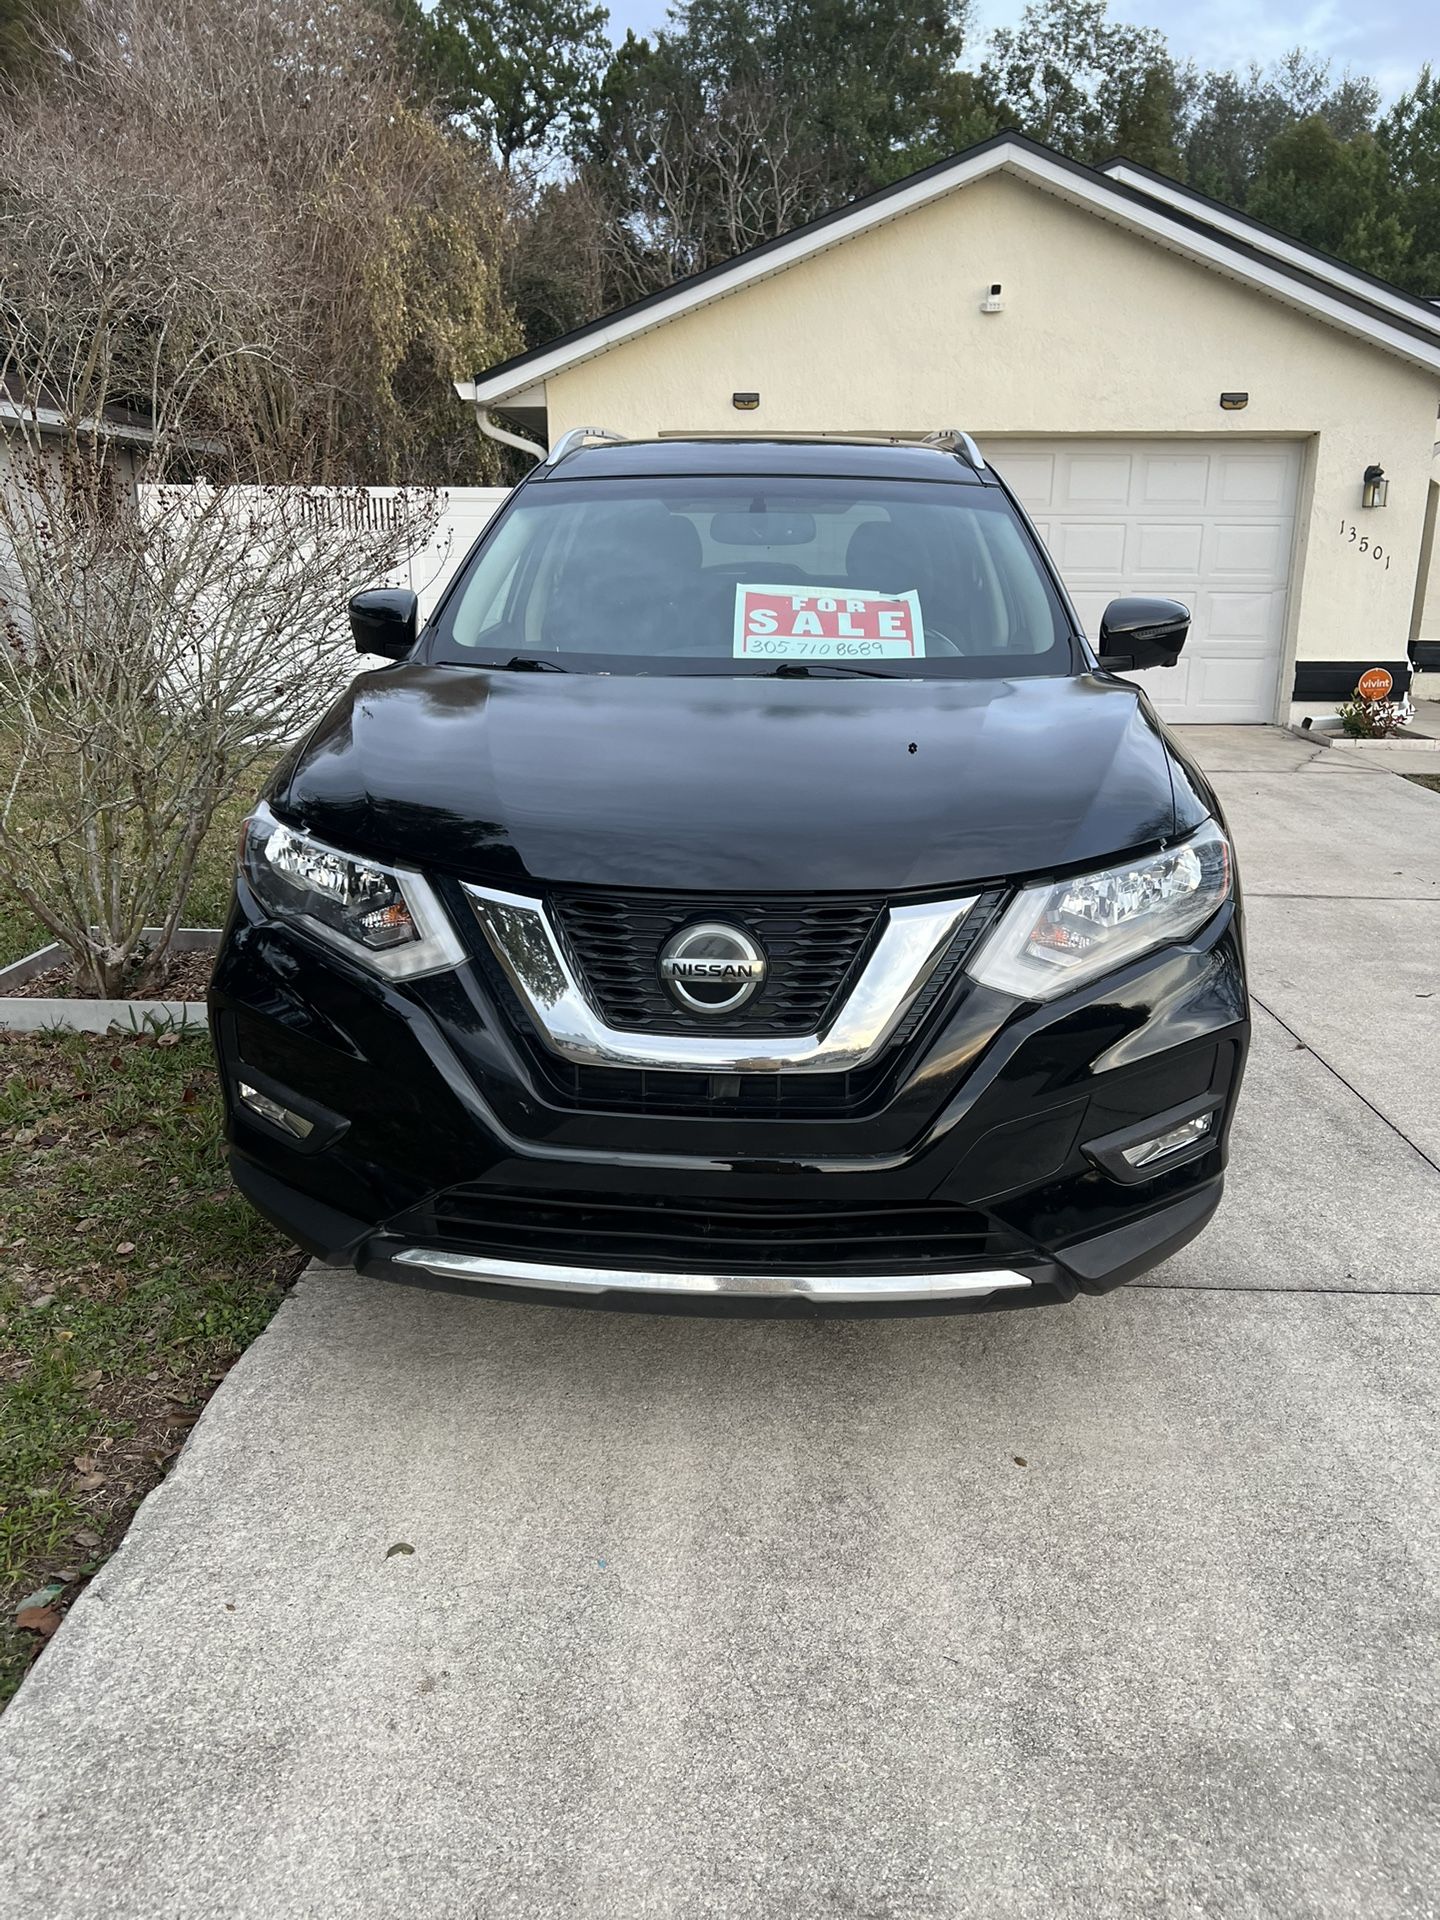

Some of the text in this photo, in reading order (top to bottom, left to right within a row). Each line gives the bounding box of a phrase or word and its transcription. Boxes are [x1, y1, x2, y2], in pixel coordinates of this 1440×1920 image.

[1340, 520, 1390, 570] 13501
[791, 596, 866, 613] FOR
[748, 609, 907, 638] SALE
[1362, 679, 1390, 688] vivint
[672, 963, 752, 977] NISSAN
